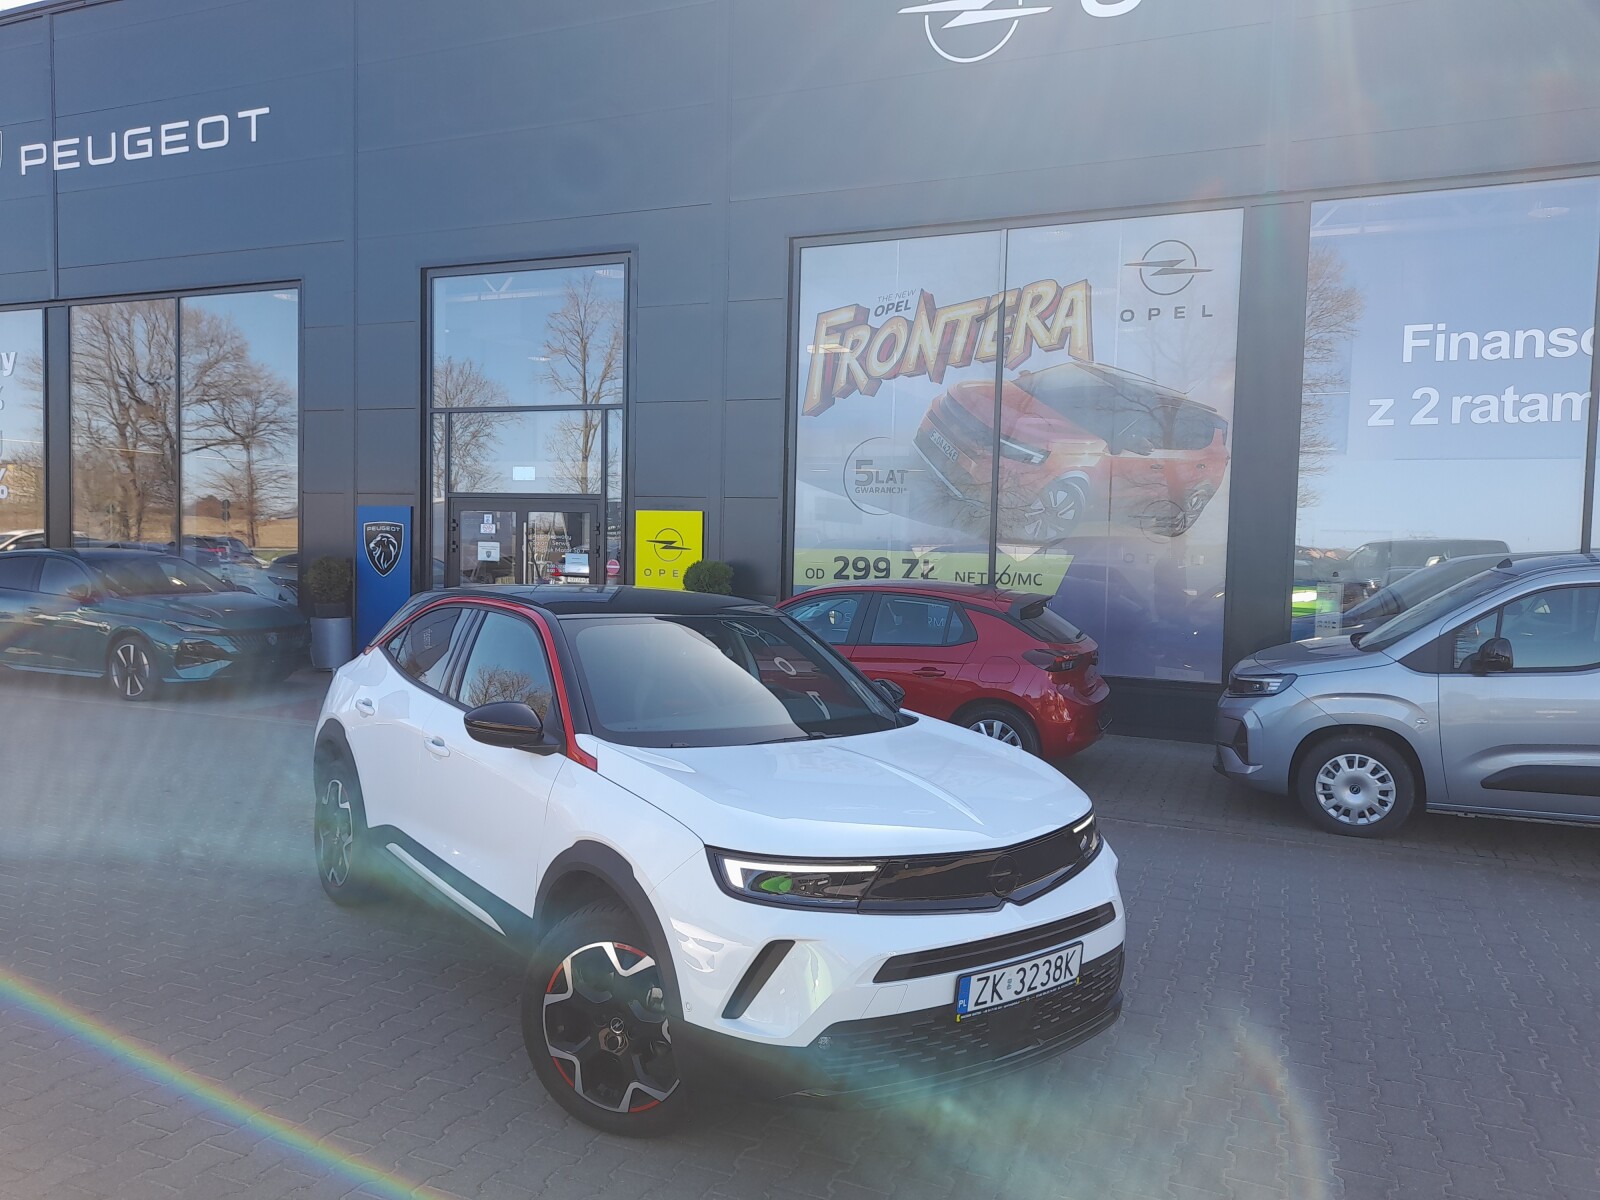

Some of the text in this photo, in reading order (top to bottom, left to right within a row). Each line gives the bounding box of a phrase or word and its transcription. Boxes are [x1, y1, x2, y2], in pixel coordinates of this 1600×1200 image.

[20, 106, 270, 176] PEUGEOT
[878, 288, 917, 303] THE NEW
[874, 299, 912, 317] OPEL
[1119, 304, 1214, 323] OPEL
[801, 278, 1095, 418] FRONTERA
[1367, 398, 1395, 427] z
[1409, 386, 1440, 426] 2
[874, 469, 909, 485] LAT
[643, 567, 680, 578] OPE
[805, 567, 825, 580] OD
[833, 555, 892, 581] 299
[954, 570, 1044, 587] NETO/MC
[974, 971, 1007, 1008] ZK
[1013, 949, 1077, 996] 3238K
[958, 999, 968, 1009] PL
